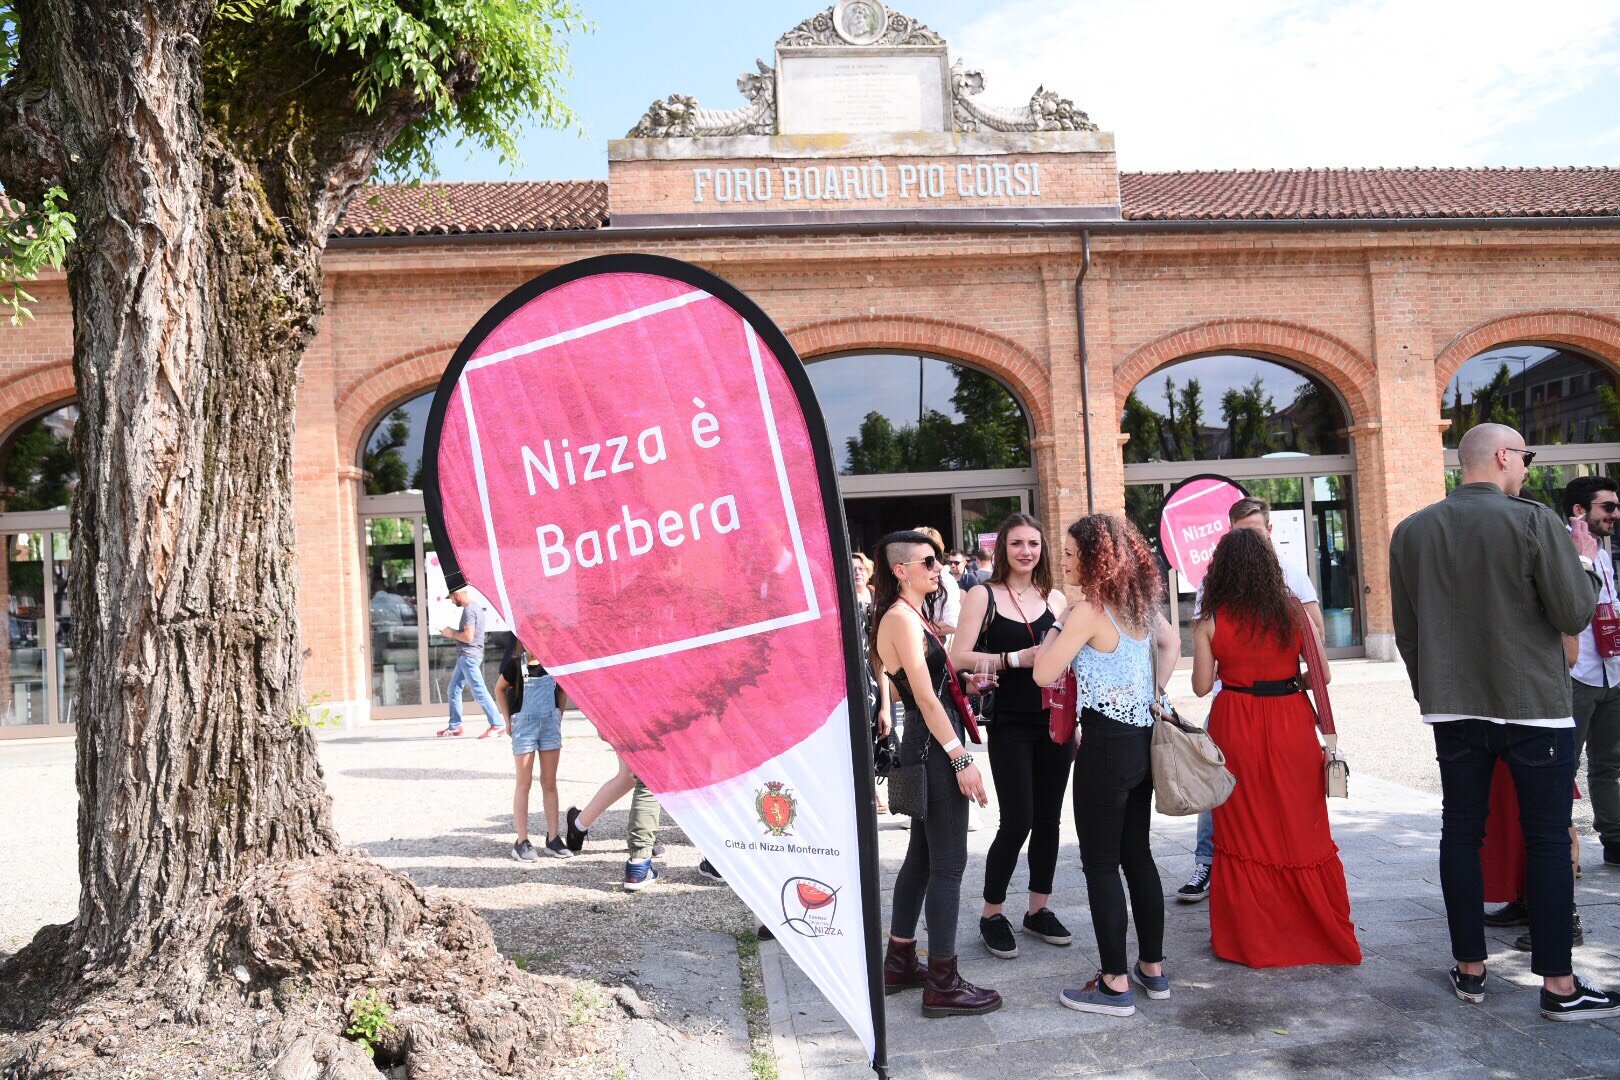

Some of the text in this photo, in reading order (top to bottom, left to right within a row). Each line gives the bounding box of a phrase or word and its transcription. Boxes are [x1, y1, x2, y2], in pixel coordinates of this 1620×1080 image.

[693, 162, 1040, 202] FORO BOARIO PIO CORSI
[521, 397, 721, 496] Nizza è
[536, 494, 741, 577] Barbera
[1181, 519, 1223, 543] Nizza
[725, 839, 840, 857] Città di Nizza Monferrato
[814, 926, 843, 936] NIZZA
